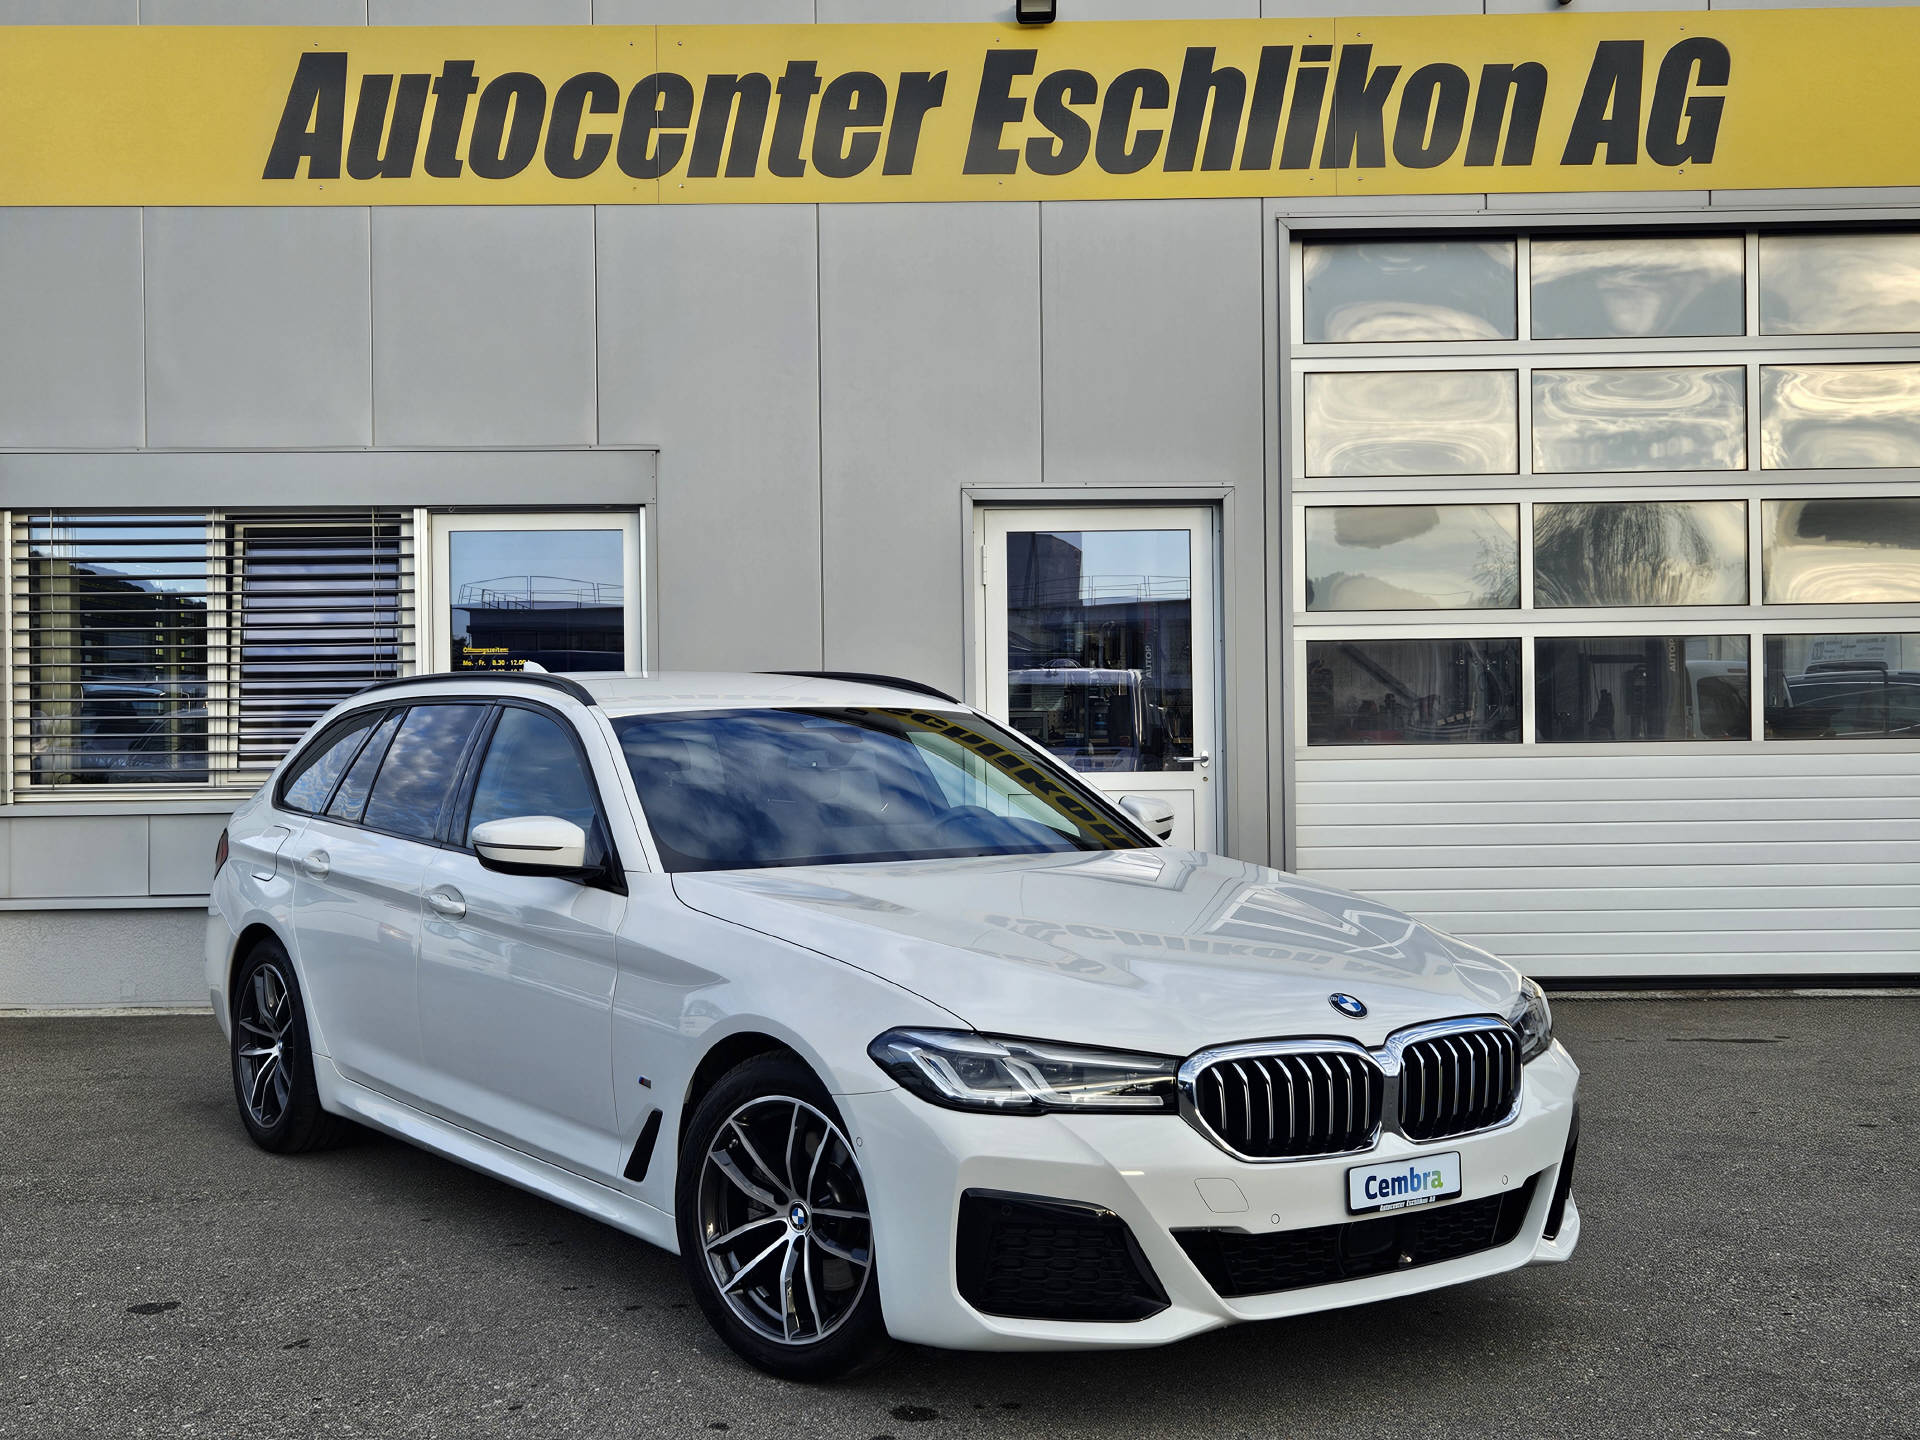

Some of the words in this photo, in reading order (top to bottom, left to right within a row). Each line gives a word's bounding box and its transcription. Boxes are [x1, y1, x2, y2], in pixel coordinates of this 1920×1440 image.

[262, 50, 948, 180] Autocenter
[963, 44, 1547, 174] Eschlikon
[1560, 37, 1730, 167] AG
[1365, 1167, 1443, 1200] Cembra
